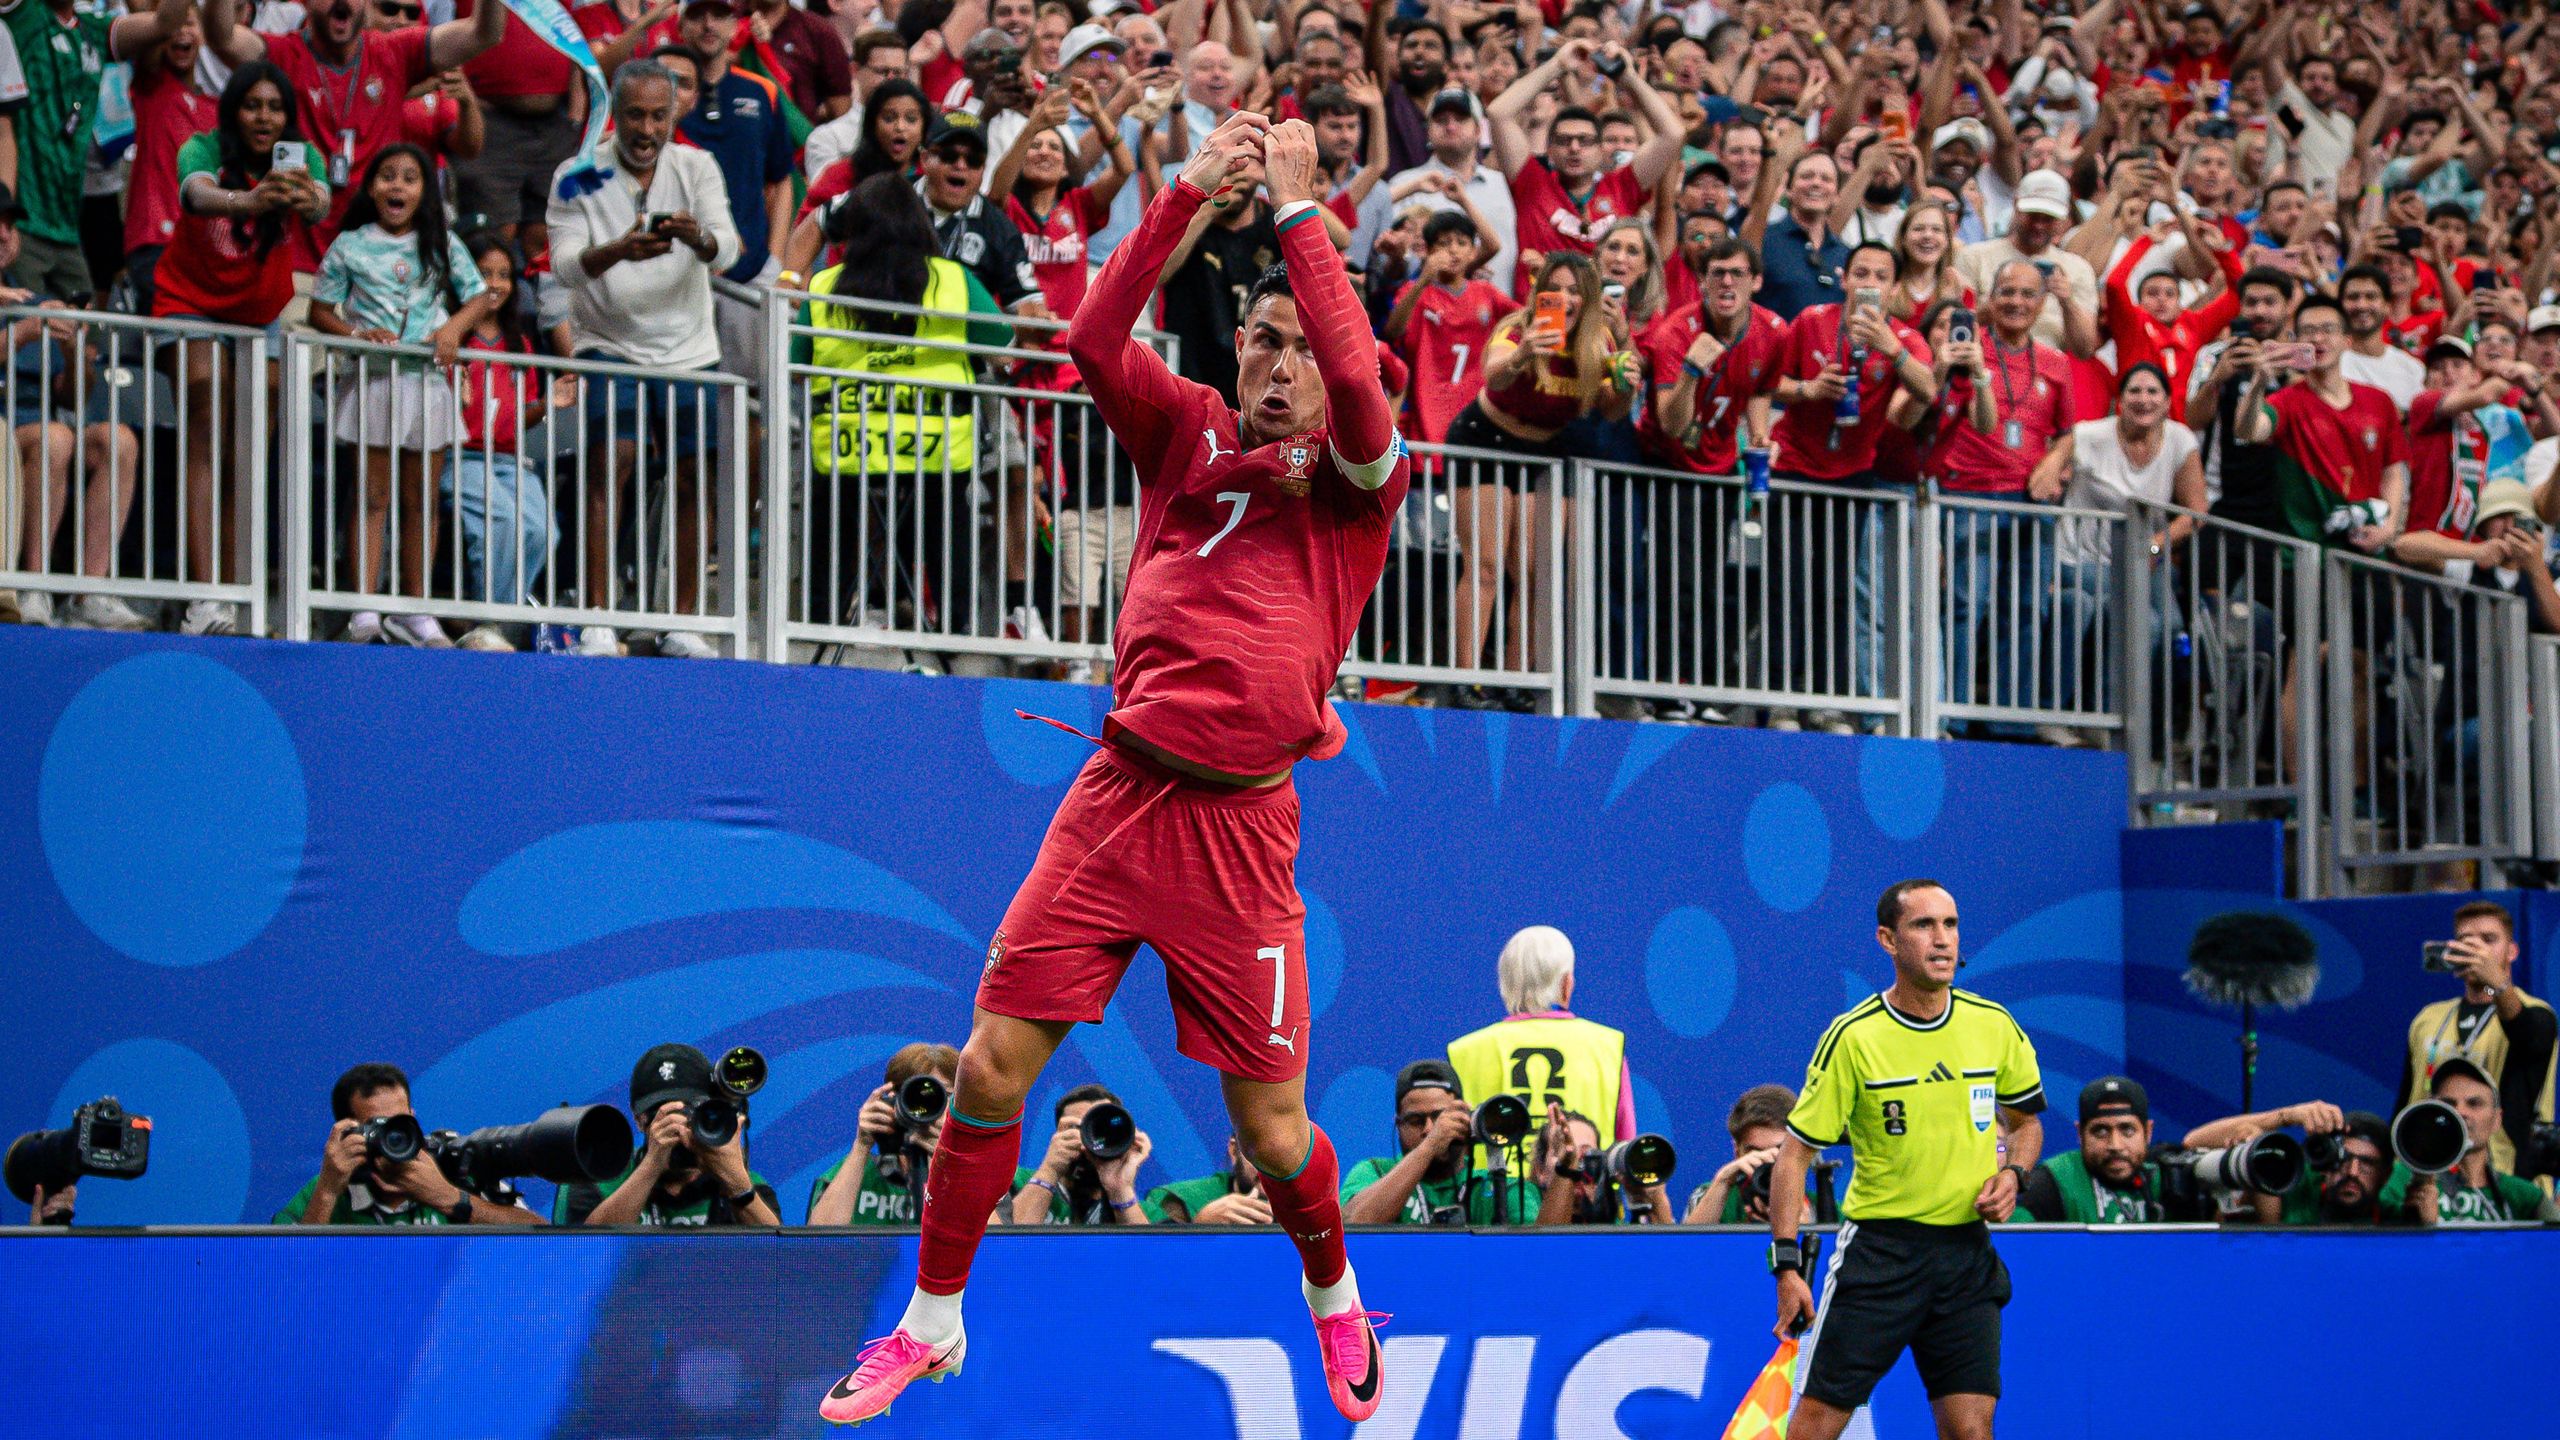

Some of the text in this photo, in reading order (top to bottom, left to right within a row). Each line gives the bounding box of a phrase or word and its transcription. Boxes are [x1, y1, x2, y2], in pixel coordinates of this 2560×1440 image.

[1451, 343, 1470, 385] 7
[1708, 396, 1731, 428] 7
[838, 428, 941, 458] 05127
[1196, 491, 1251, 558] 7
[1257, 944, 1286, 1028] 7
[1973, 1088, 1994, 1100] FIFA
